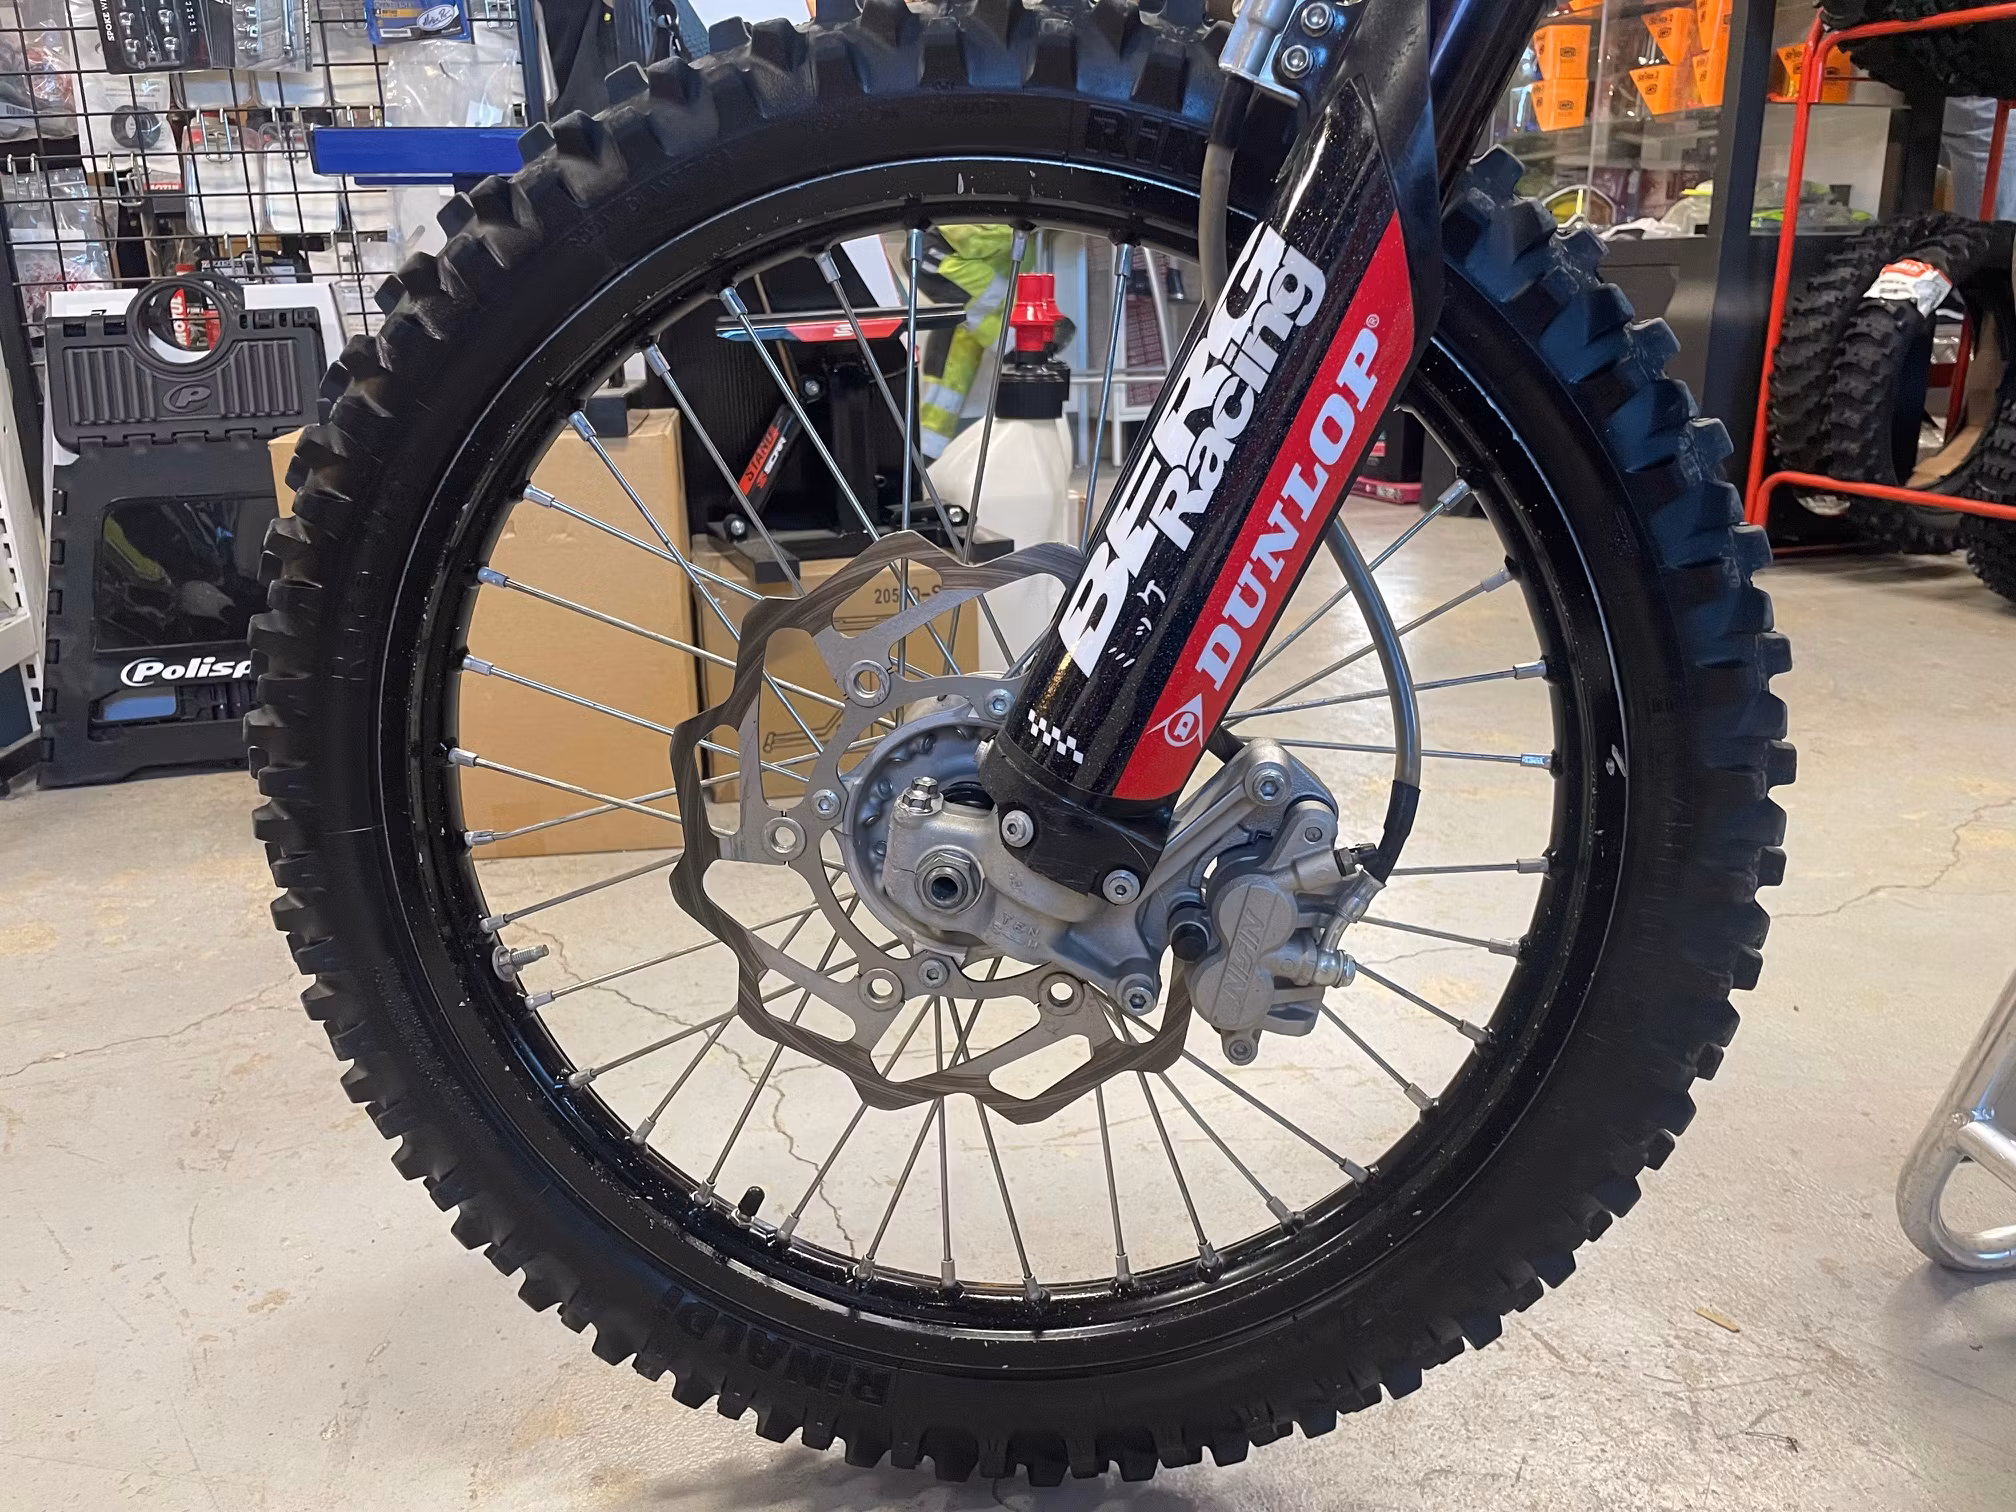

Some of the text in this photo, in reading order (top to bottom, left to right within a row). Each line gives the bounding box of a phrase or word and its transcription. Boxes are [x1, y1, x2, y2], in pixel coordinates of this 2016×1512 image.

[102, 12, 115, 42] SPOKE
[170, 295, 188, 345] MOTUL
[1058, 224, 1286, 678] BERG
[1151, 244, 1327, 552] Racing
[1194, 326, 1380, 692] DUNLOP
